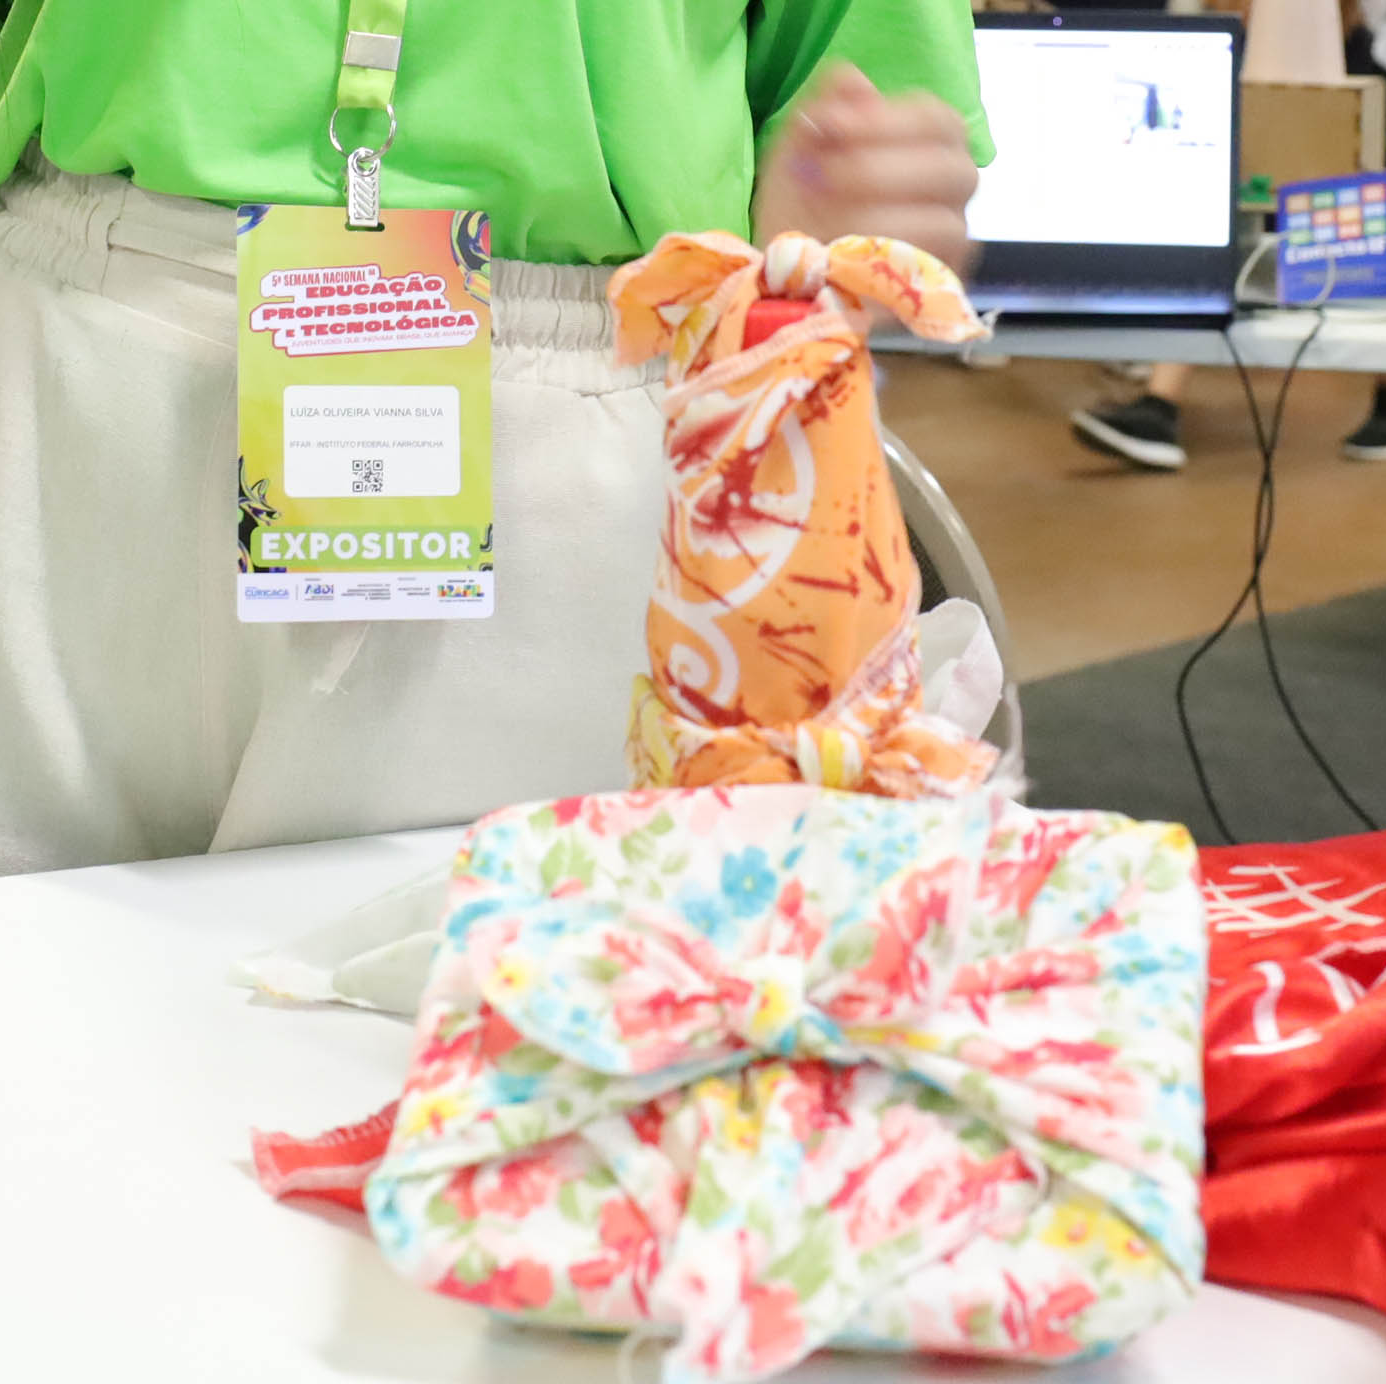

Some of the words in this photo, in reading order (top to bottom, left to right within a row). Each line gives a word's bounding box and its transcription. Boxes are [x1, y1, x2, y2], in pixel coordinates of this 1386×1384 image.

[284, 272, 321, 287] SEMANA
[323, 269, 366, 285] NACIONAL
[306, 274, 442, 299] EDUCAÇÃO
[262, 298, 446, 321] PROFISSIONAL
[300, 314, 476, 337] TECNOLÓGICA
[323, 407, 371, 417] OLIVEIRA
[373, 407, 412, 417] VIANNA
[414, 407, 444, 417] SILVA
[261, 532, 471, 560] EXPOSITOR
